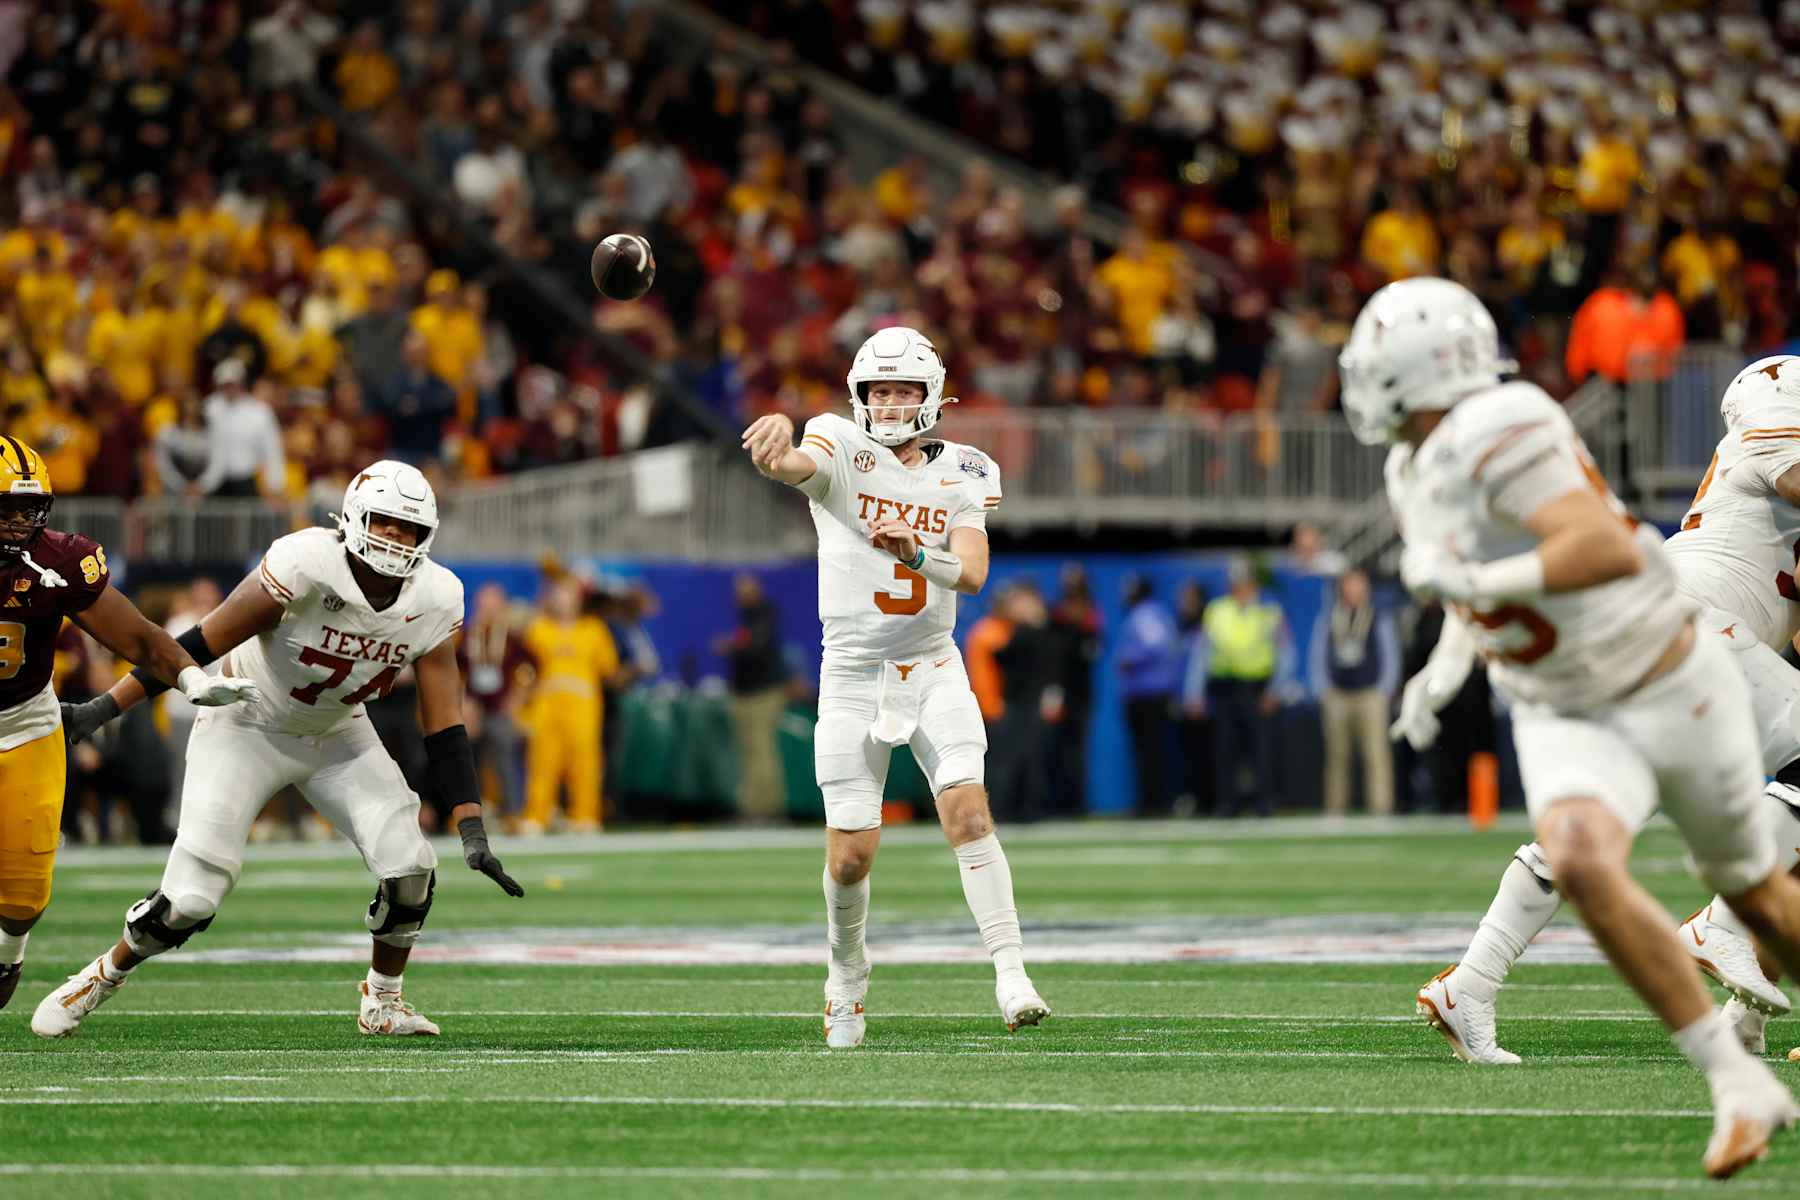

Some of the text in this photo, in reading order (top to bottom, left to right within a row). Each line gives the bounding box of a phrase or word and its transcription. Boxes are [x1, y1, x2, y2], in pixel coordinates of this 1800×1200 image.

[854, 450, 876, 472] SEC
[857, 492, 948, 535] TEXAS
[320, 624, 410, 664] TEXAS
